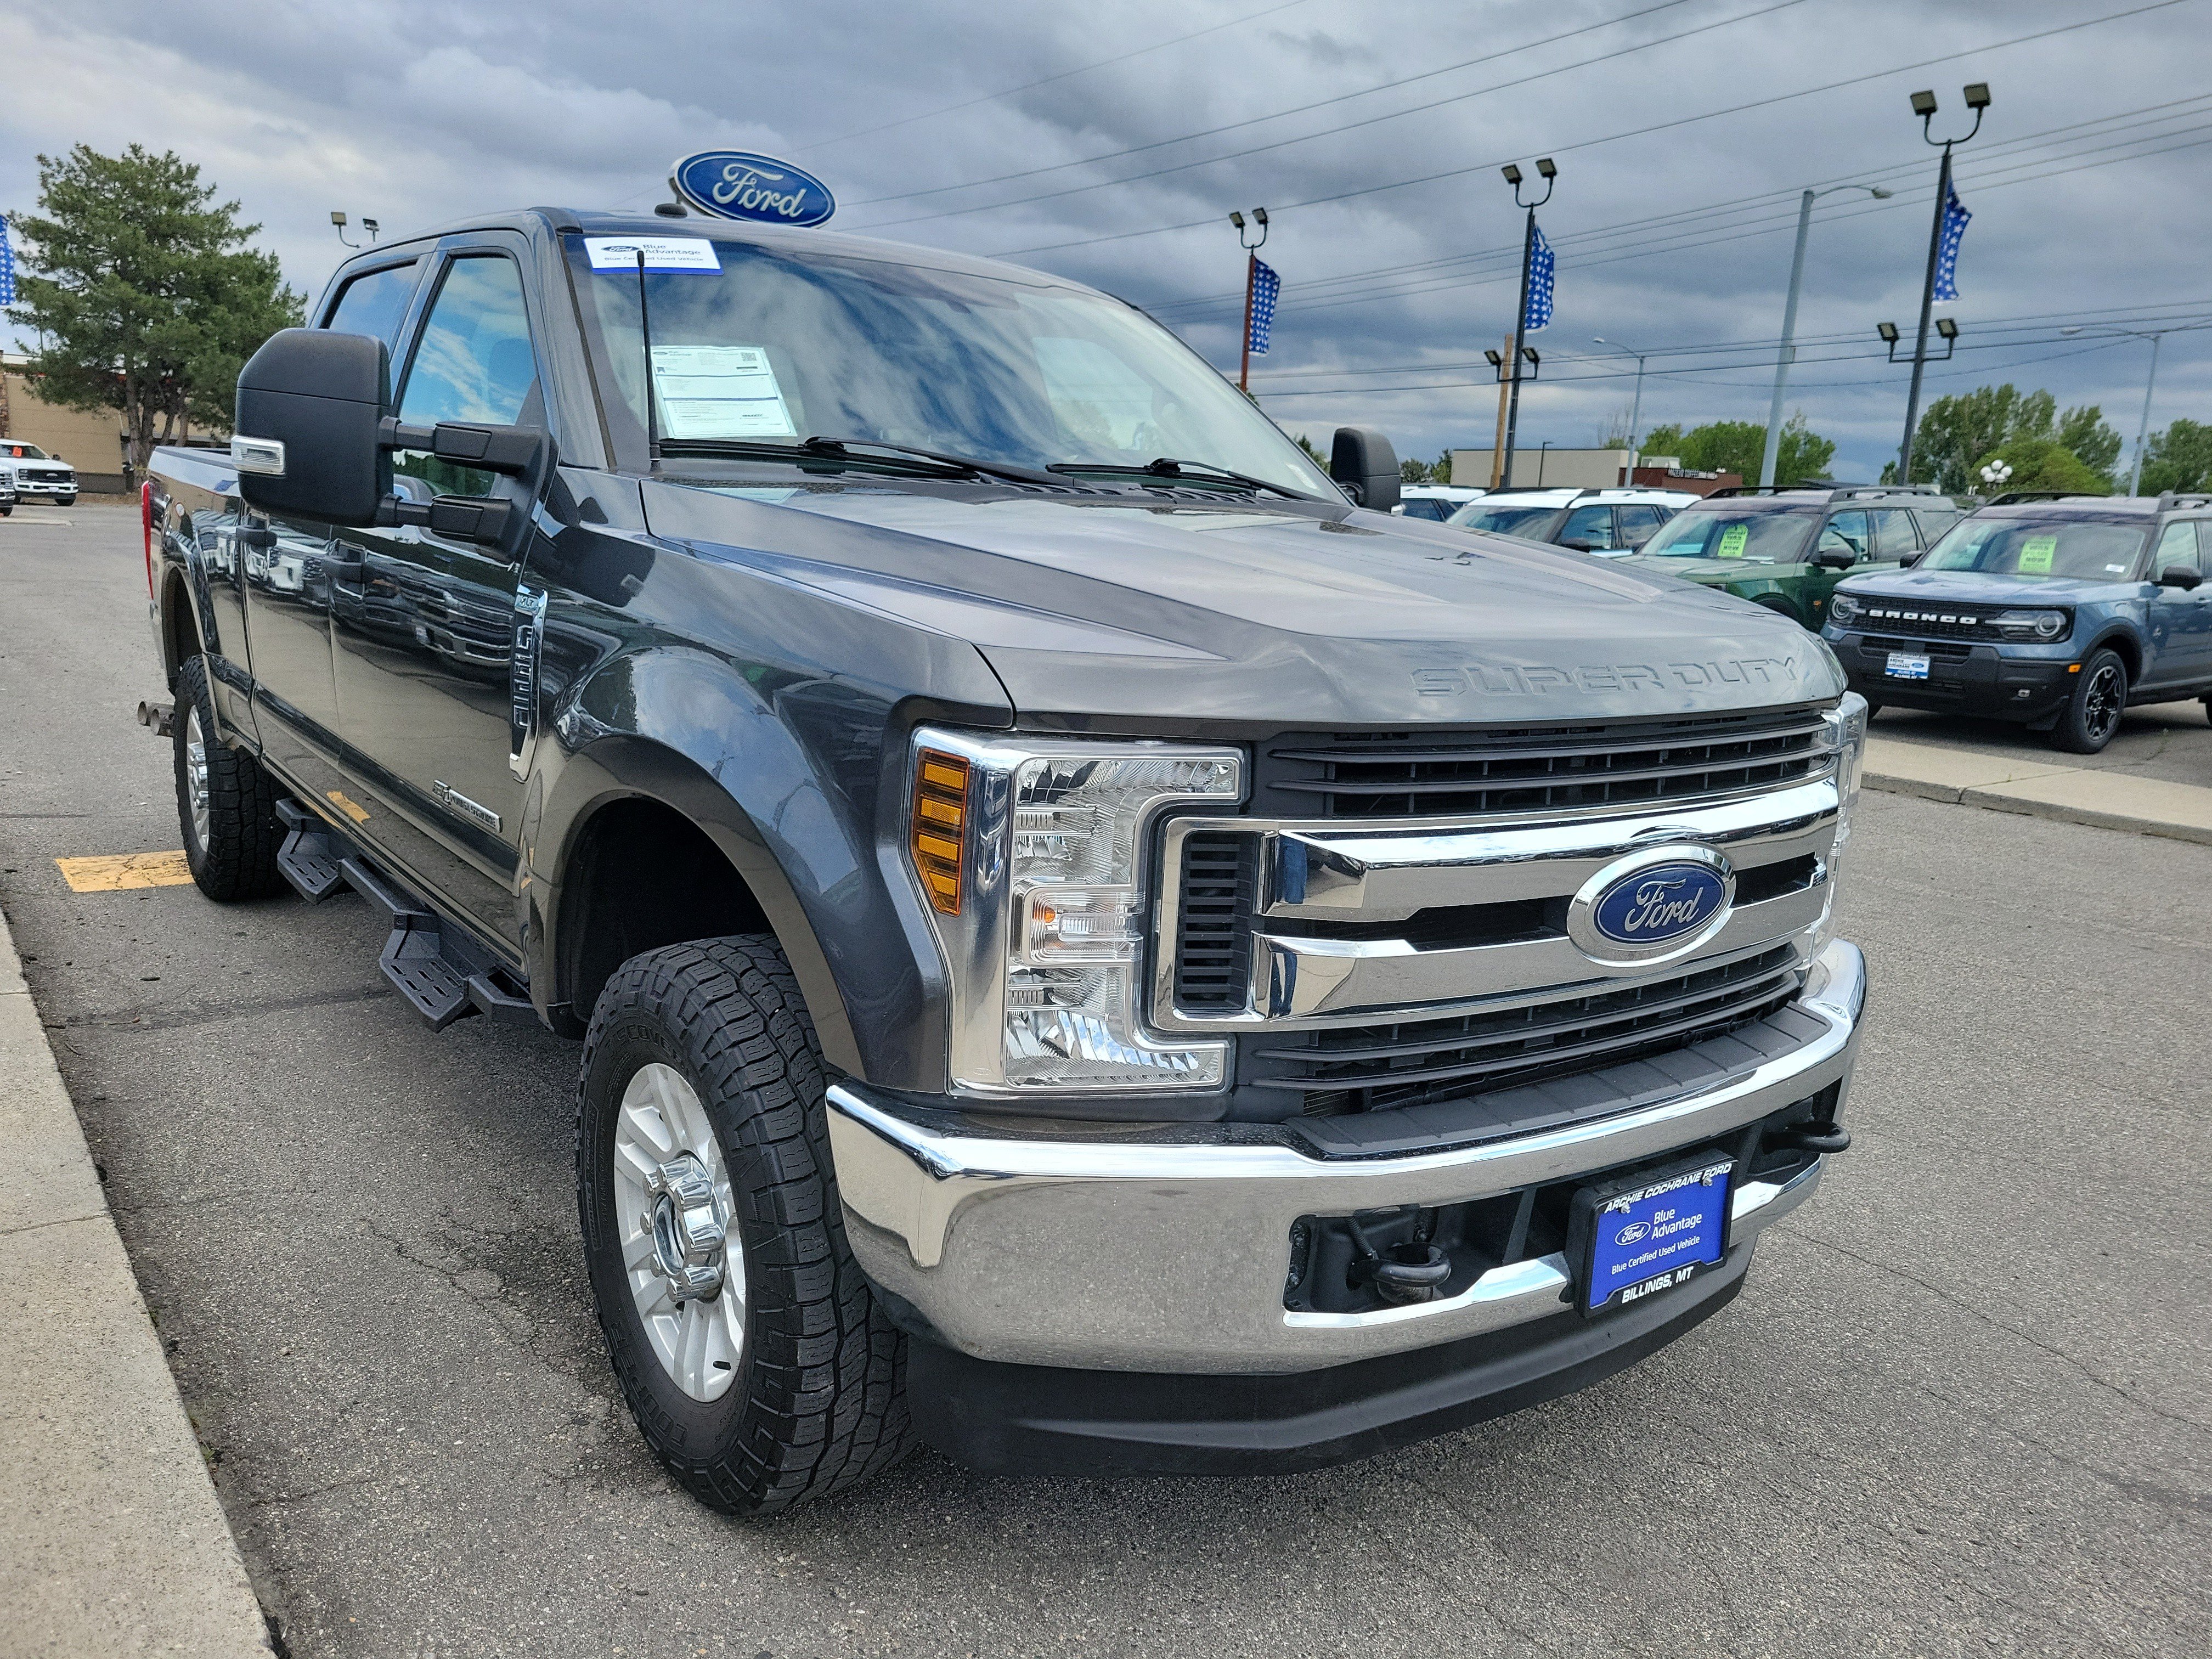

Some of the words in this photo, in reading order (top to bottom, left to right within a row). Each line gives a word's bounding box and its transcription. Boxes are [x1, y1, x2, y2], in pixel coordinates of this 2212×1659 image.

[713, 163, 807, 218] Ford
[1869, 608, 1977, 625] BRONCO
[1410, 663, 1664, 697] SUPER
[1667, 657, 1797, 686] DUTY
[1624, 877, 1704, 932] Ford
[1604, 1190, 1645, 1214] ARCHIE
[1644, 1171, 1703, 1199] COCHRANE
[1702, 1163, 1733, 1180] FORD
[1621, 1225, 1645, 1243] Ford
[1651, 1214, 1702, 1240] Advantage
[1654, 1209, 1675, 1225] Blue
[1611, 1262, 1627, 1275] Blue
[1628, 1249, 1657, 1268] Certified
[1658, 1244, 1676, 1257] Used
[1677, 1235, 1700, 1251] Vehicle
[1621, 1274, 1673, 1304] BILLINGS,
[1675, 1266, 1694, 1283] MT
